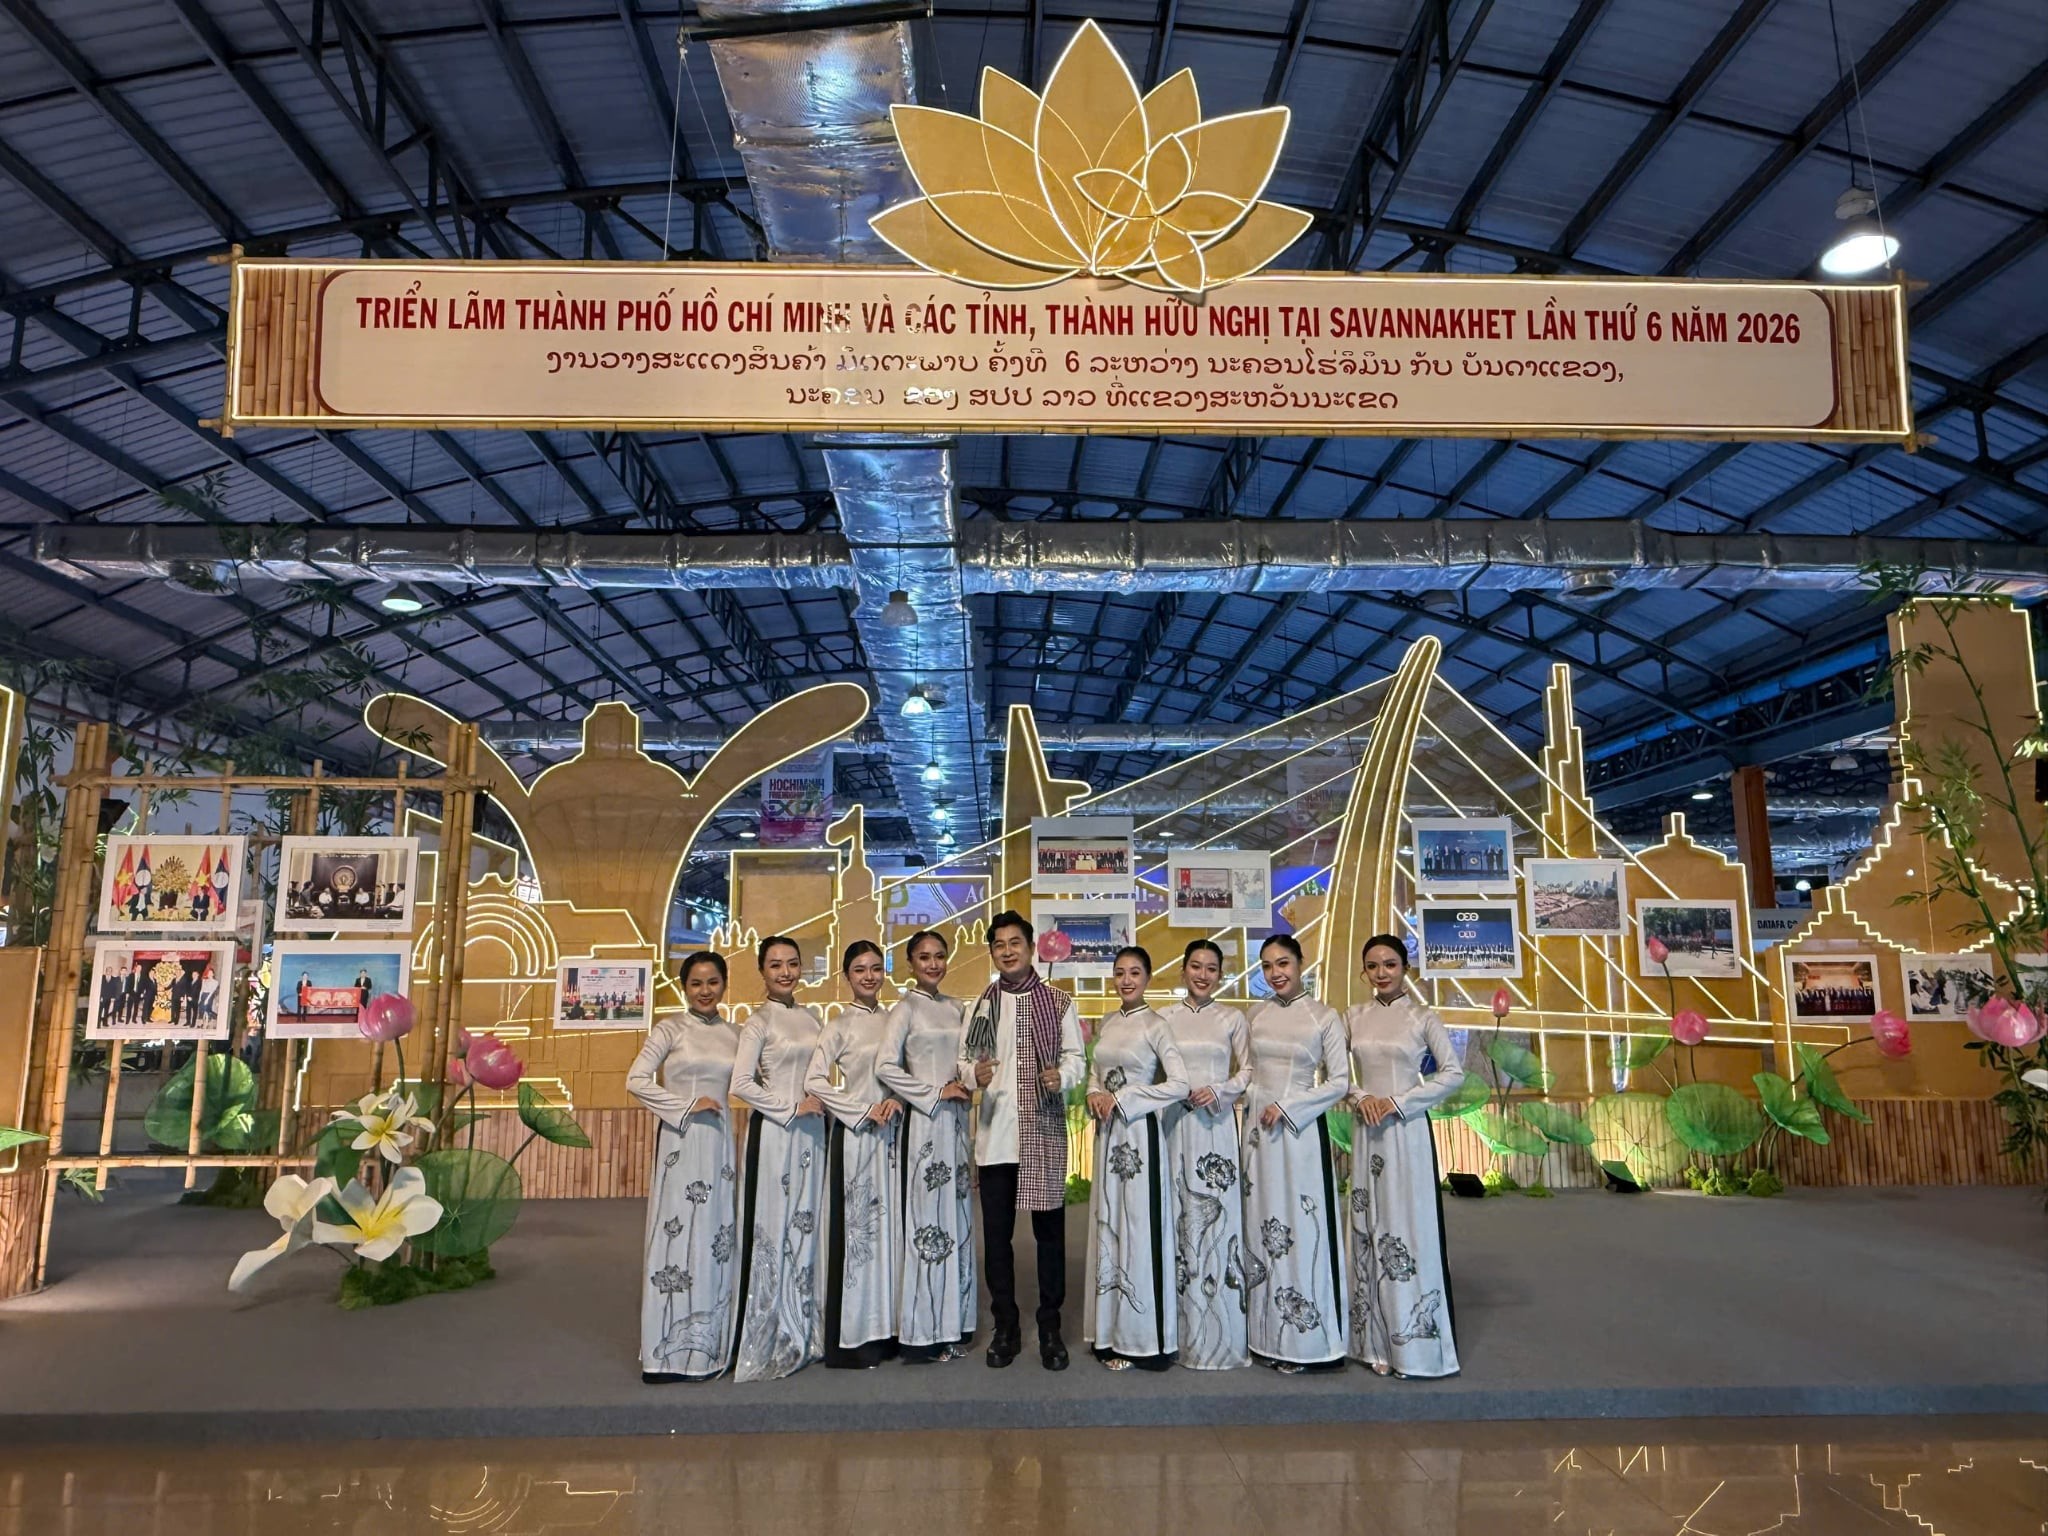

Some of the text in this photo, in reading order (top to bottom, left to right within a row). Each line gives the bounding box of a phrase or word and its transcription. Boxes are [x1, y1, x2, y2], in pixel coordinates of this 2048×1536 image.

[356, 280, 1801, 345] TRIỂN LÃM THÀNH PHỐ HỒ CHÍ MINH VÀ CÁC TỈNH, THÀNH HỮU NGHỊ TẠI SAVANNAKHET LẦN THỨ 6 NĂM 2026
[1064, 350, 1080, 374] 6
[1041, 388, 1097, 407] ລາວ
